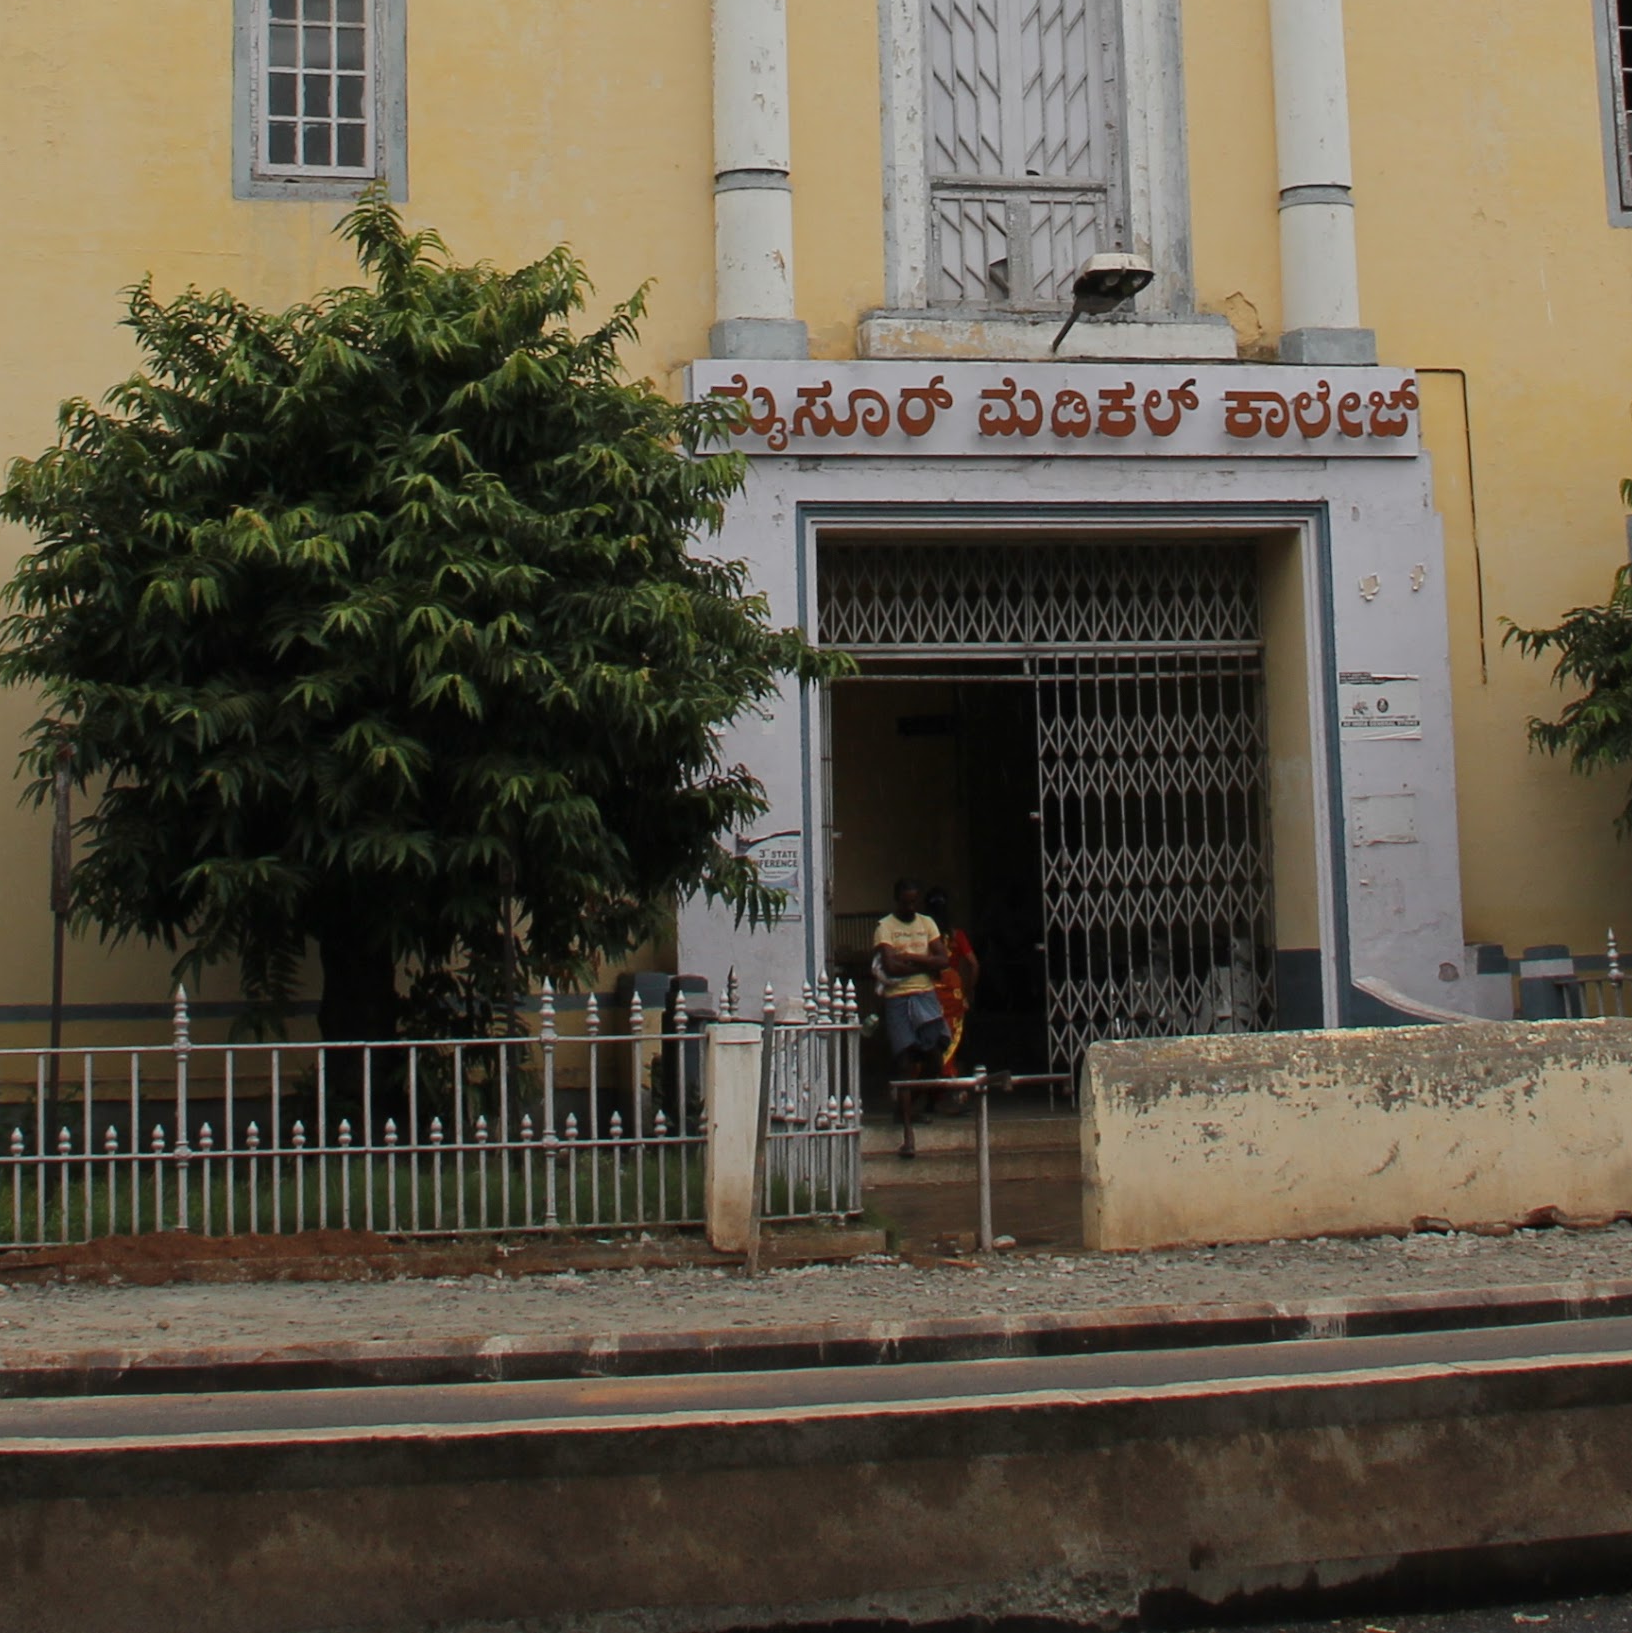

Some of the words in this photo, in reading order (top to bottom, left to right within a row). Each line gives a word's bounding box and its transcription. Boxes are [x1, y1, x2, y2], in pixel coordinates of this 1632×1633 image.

[710, 373, 953, 451] ಮೈಸೂರ್
[978, 376, 1199, 438] ಮೆಡಿಕಲ್
[1224, 378, 1420, 438] ಕಾಲೇಜ್
[771, 850, 798, 858] STATE
